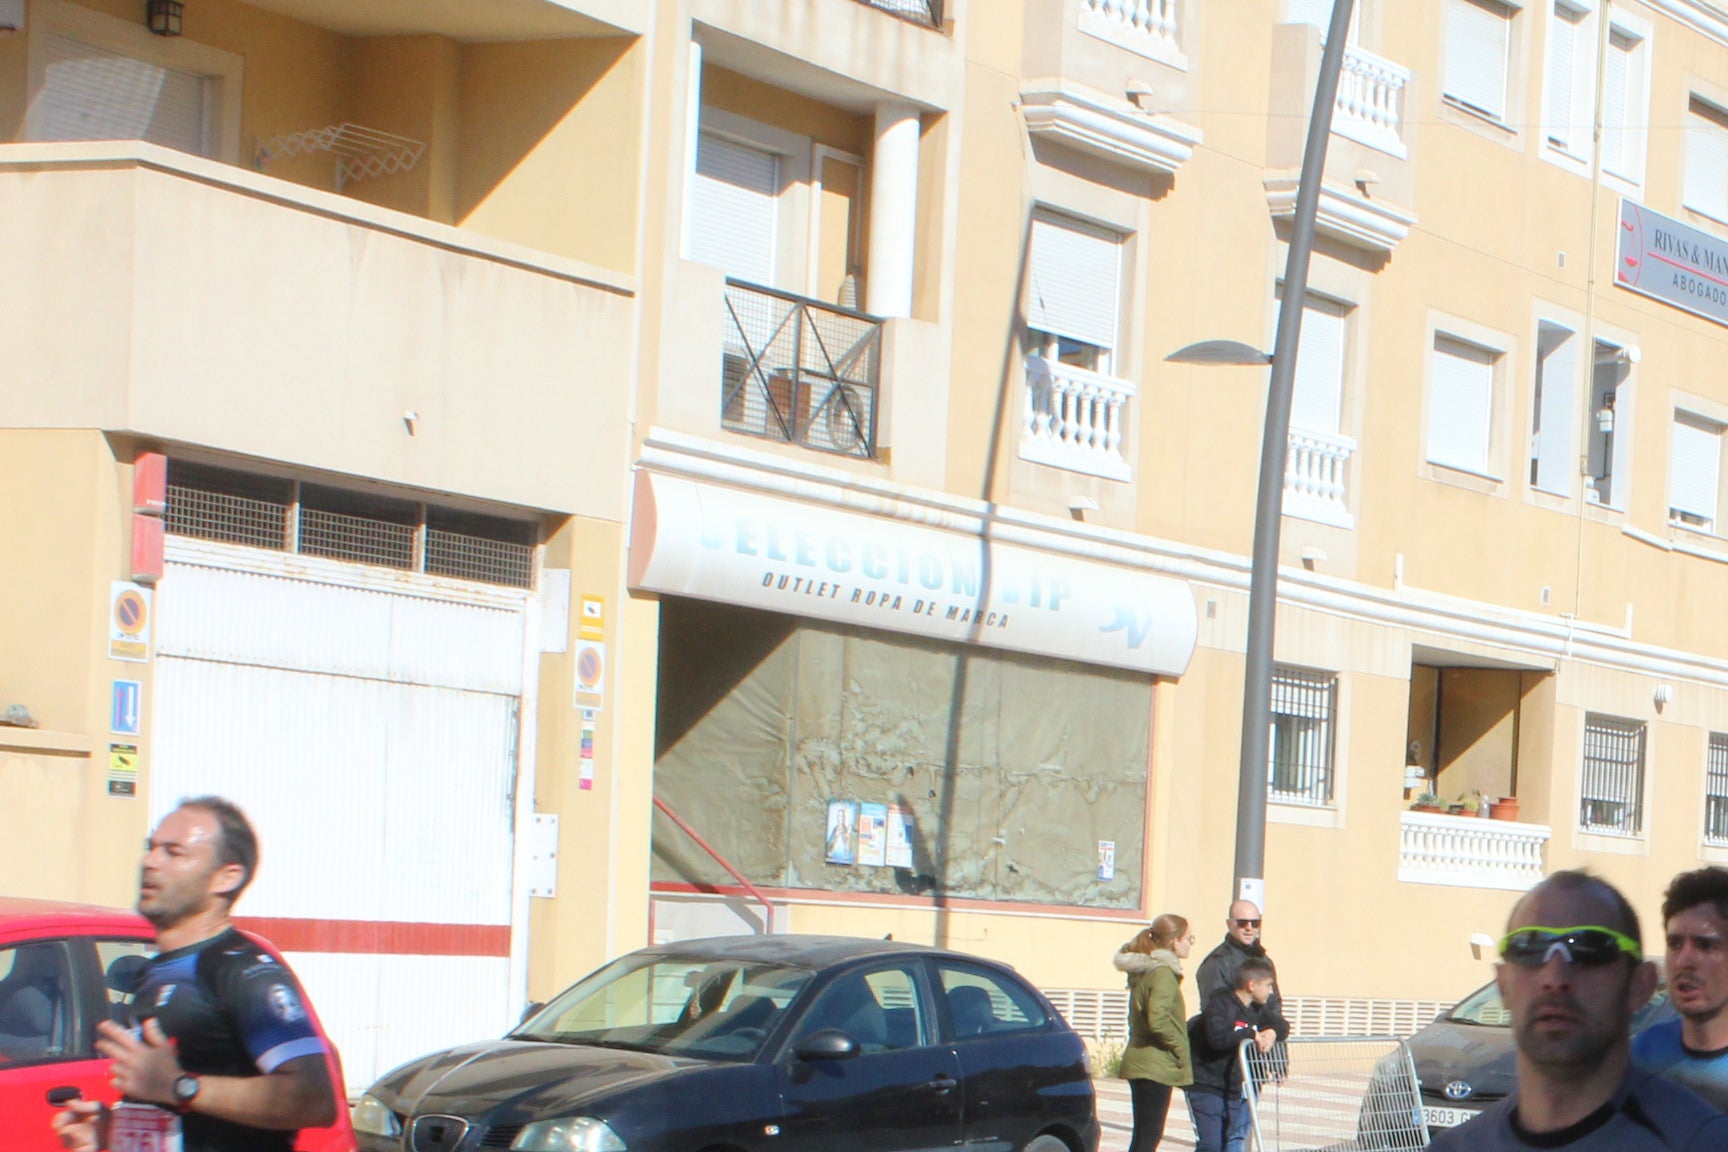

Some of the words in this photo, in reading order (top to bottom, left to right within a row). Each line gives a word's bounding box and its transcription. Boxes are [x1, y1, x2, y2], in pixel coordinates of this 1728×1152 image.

[1655, 229, 1689, 260] RIVAS
[1691, 245, 1701, 265] &
[761, 571, 841, 600] OUTLET
[851, 588, 904, 611] ROPA
[913, 599, 937, 616] DE
[945, 604, 1009, 629] MARCA
